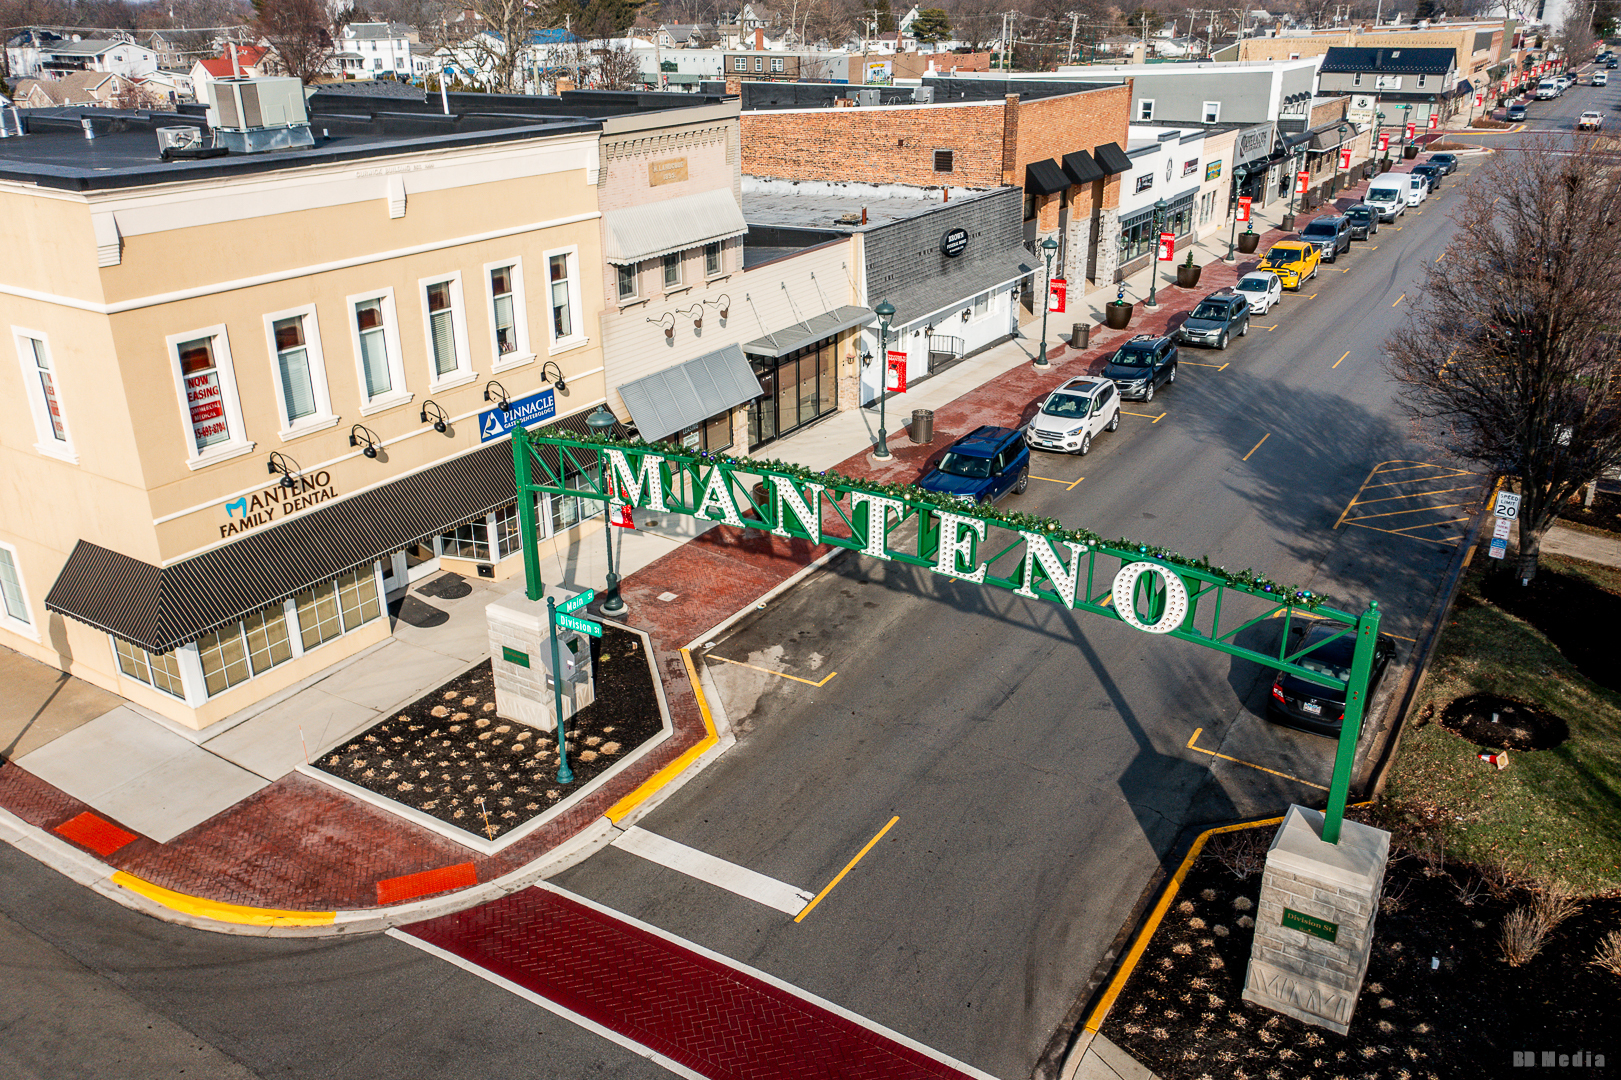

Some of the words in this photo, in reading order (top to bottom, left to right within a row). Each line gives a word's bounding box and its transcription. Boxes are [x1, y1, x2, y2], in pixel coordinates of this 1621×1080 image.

[385, 164, 411, 175] BUILDING
[187, 374, 209, 389] NOW
[187, 385, 219, 402] EASING
[190, 401, 220, 415] OMMERCIAL
[502, 395, 554, 423] PINNACLE
[504, 406, 554, 429] GASTOENTEROLOGY
[225, 470, 331, 518] MANTENO
[1500, 493, 1519, 502] SPEED
[219, 507, 274, 538] FAMILY
[282, 486, 339, 515] DENTAL
[1496, 504, 1516, 517] 20
[603, 448, 1189, 635] MANTENO
[566, 597, 584, 612] Main
[560, 615, 592, 633] Division
[1287, 912, 1322, 929] Division
[1322, 924, 1335, 933] St.
